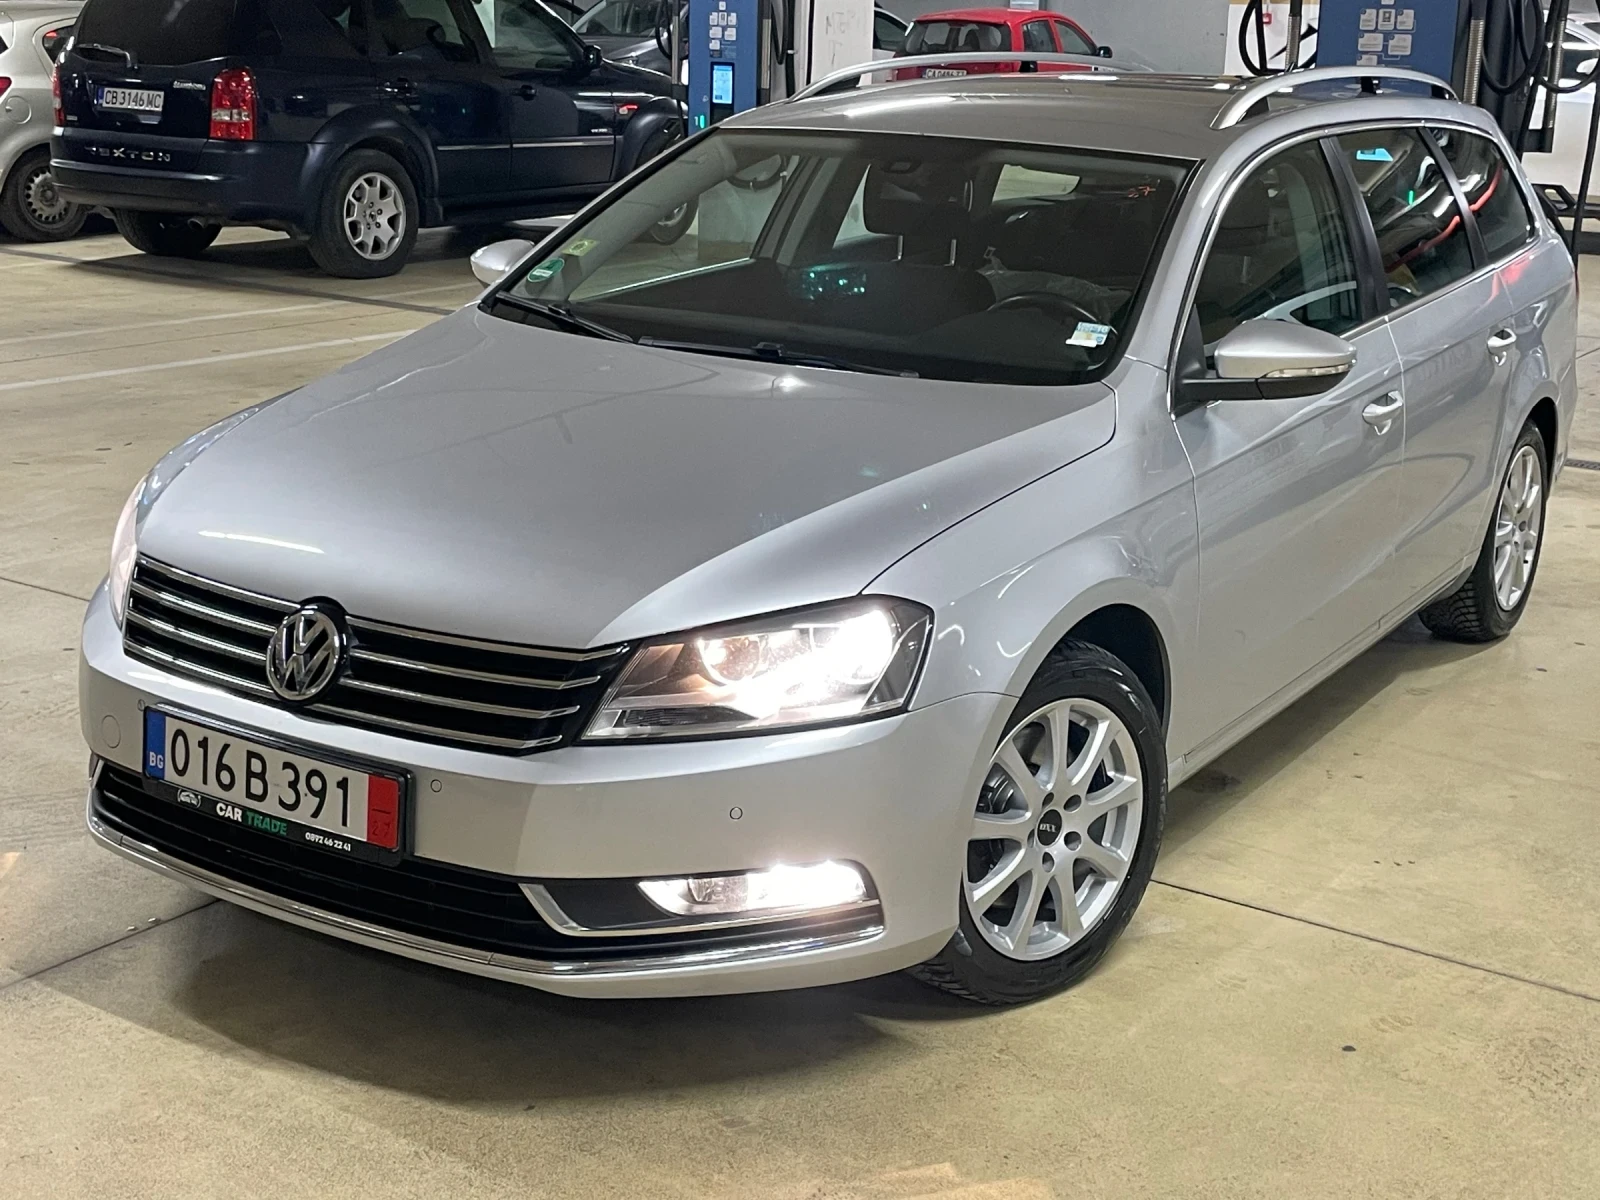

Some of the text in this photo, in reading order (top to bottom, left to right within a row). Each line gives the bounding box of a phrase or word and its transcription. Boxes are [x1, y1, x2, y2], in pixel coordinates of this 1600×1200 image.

[149, 751, 164, 769] BG
[215, 802, 287, 836] CAR TRADE
[333, 840, 343, 849] 22
[343, 842, 351, 852] 41
